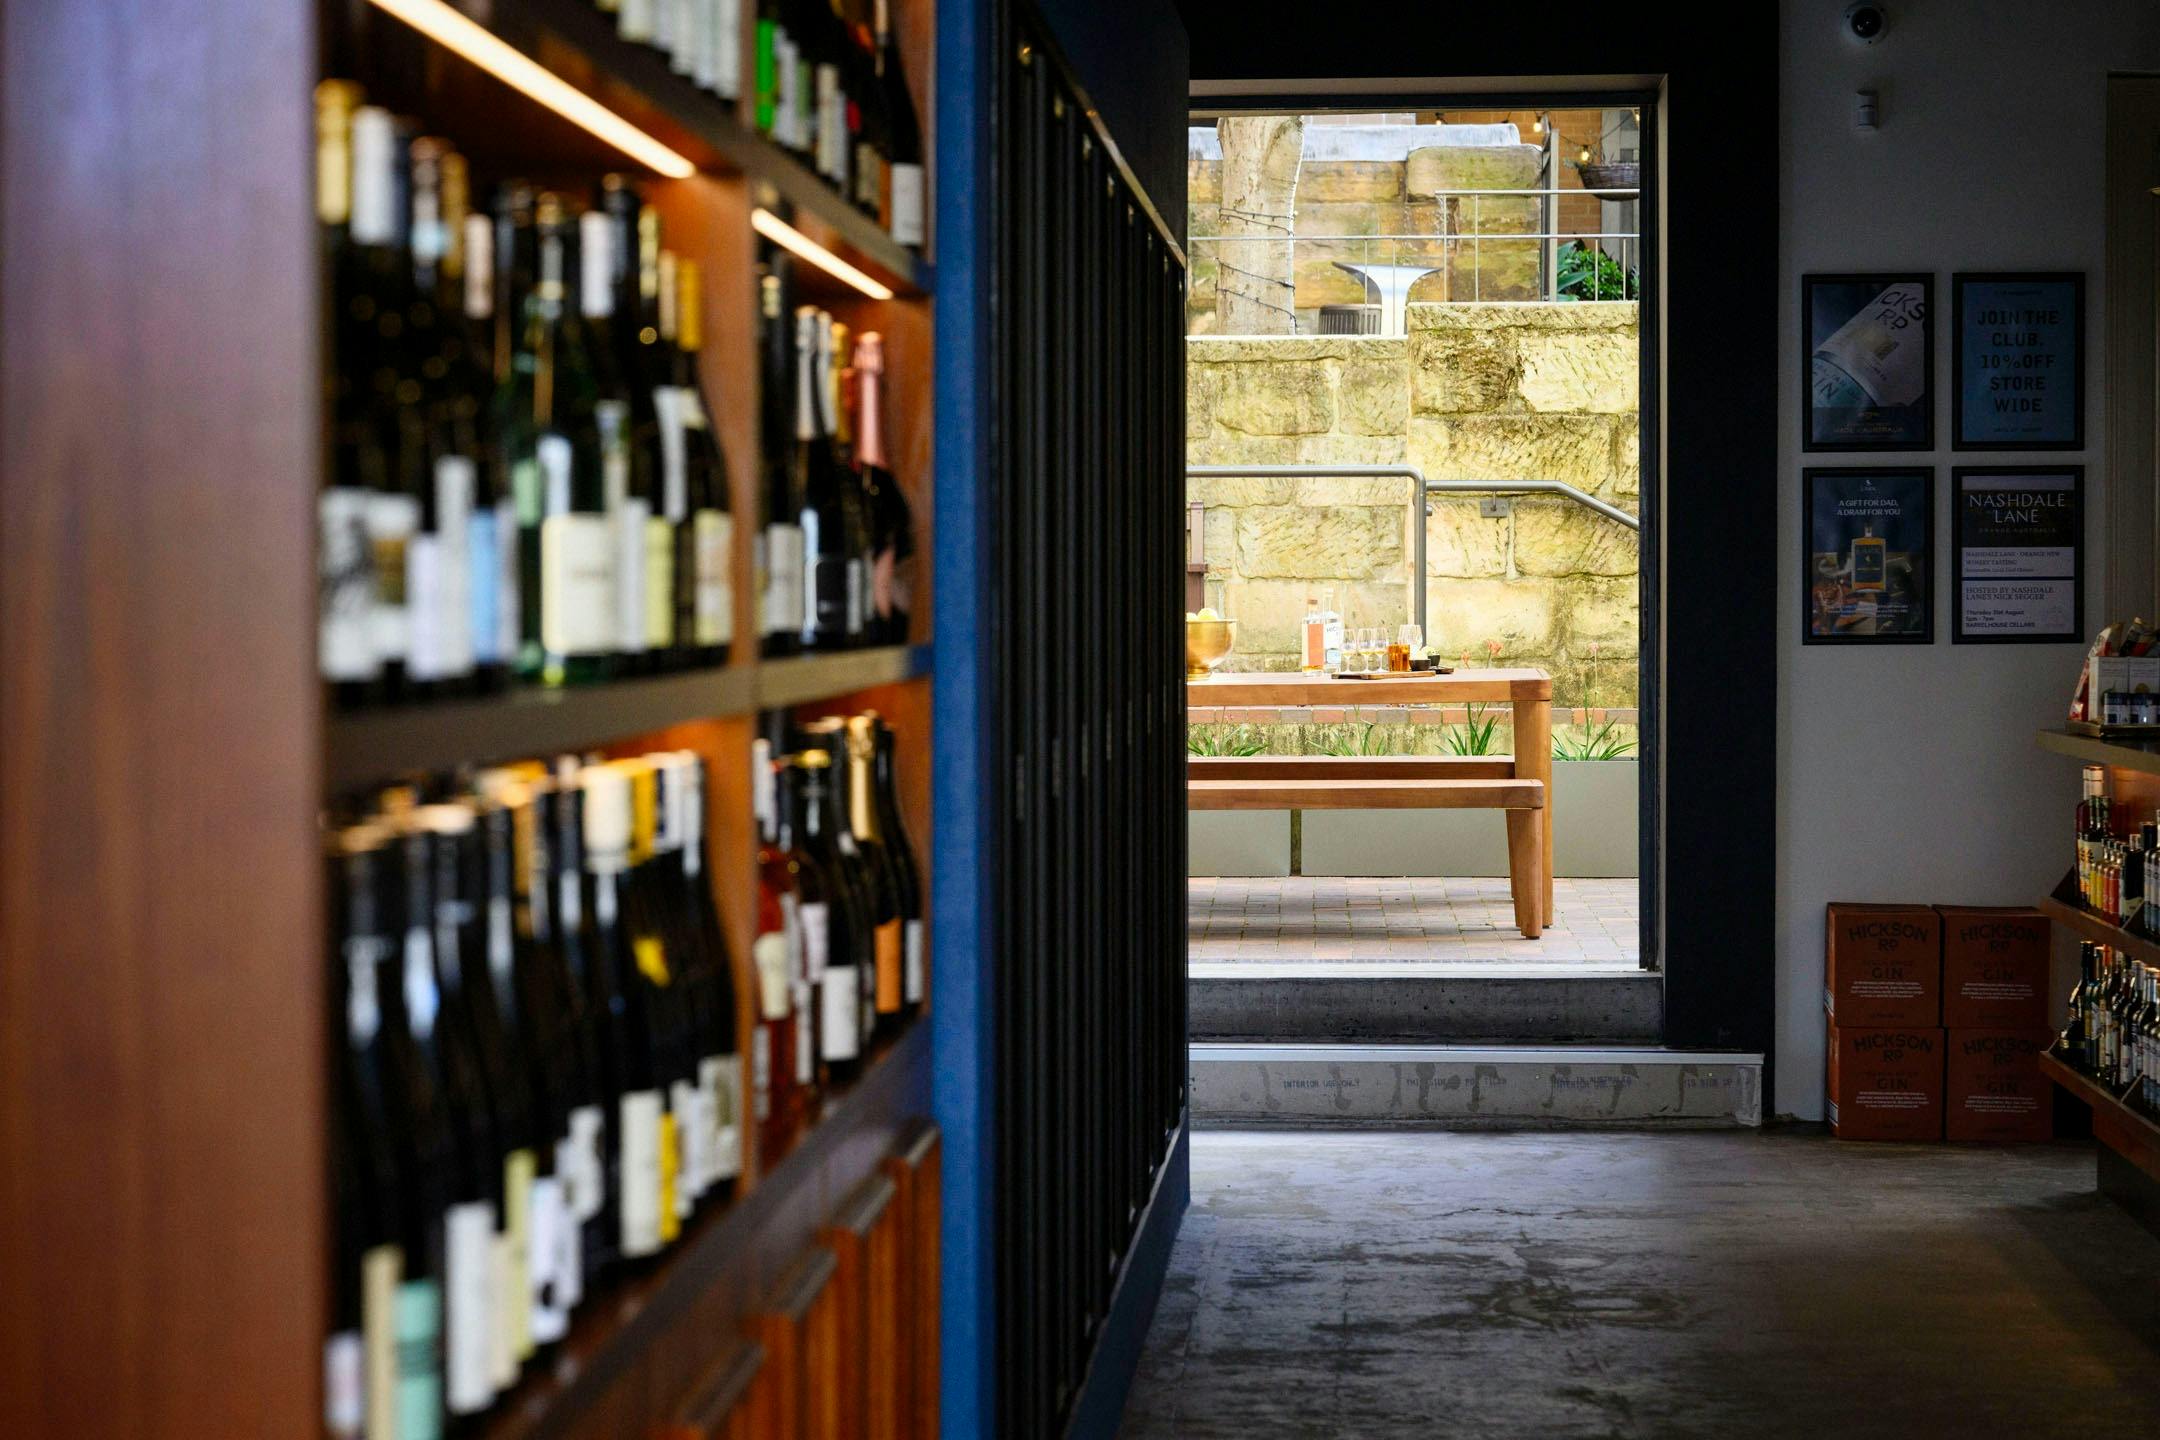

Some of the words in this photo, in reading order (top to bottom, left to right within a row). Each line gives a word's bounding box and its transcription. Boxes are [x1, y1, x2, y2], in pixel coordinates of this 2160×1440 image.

[1977, 310, 2019, 325] JOIN
[2024, 310, 2059, 325] THE
[1991, 333, 2044, 347] CLUB.
[1990, 376, 2046, 391] STORE
[1994, 398, 2043, 413] WIDE
[1839, 499, 1845, 507] A
[1845, 499, 1862, 507] GIFT
[1863, 499, 1879, 507] FOR
[1969, 493, 2065, 508] NASHDALE
[1843, 508, 1866, 516] DRAM
[1866, 508, 1883, 516] FOR
[1883, 508, 1901, 516] YOU
[1994, 509, 2039, 523] LANE
[1849, 921, 1928, 942] HICKSON
[1960, 922, 2039, 944] HICKSON
[1872, 967, 1903, 979] GIN
[1984, 968, 2015, 980] GIN
[1854, 1033, 1933, 1053] HICKSON
[1877, 1079, 1908, 1090] GIN
[1987, 1081, 2017, 1094] GIN
